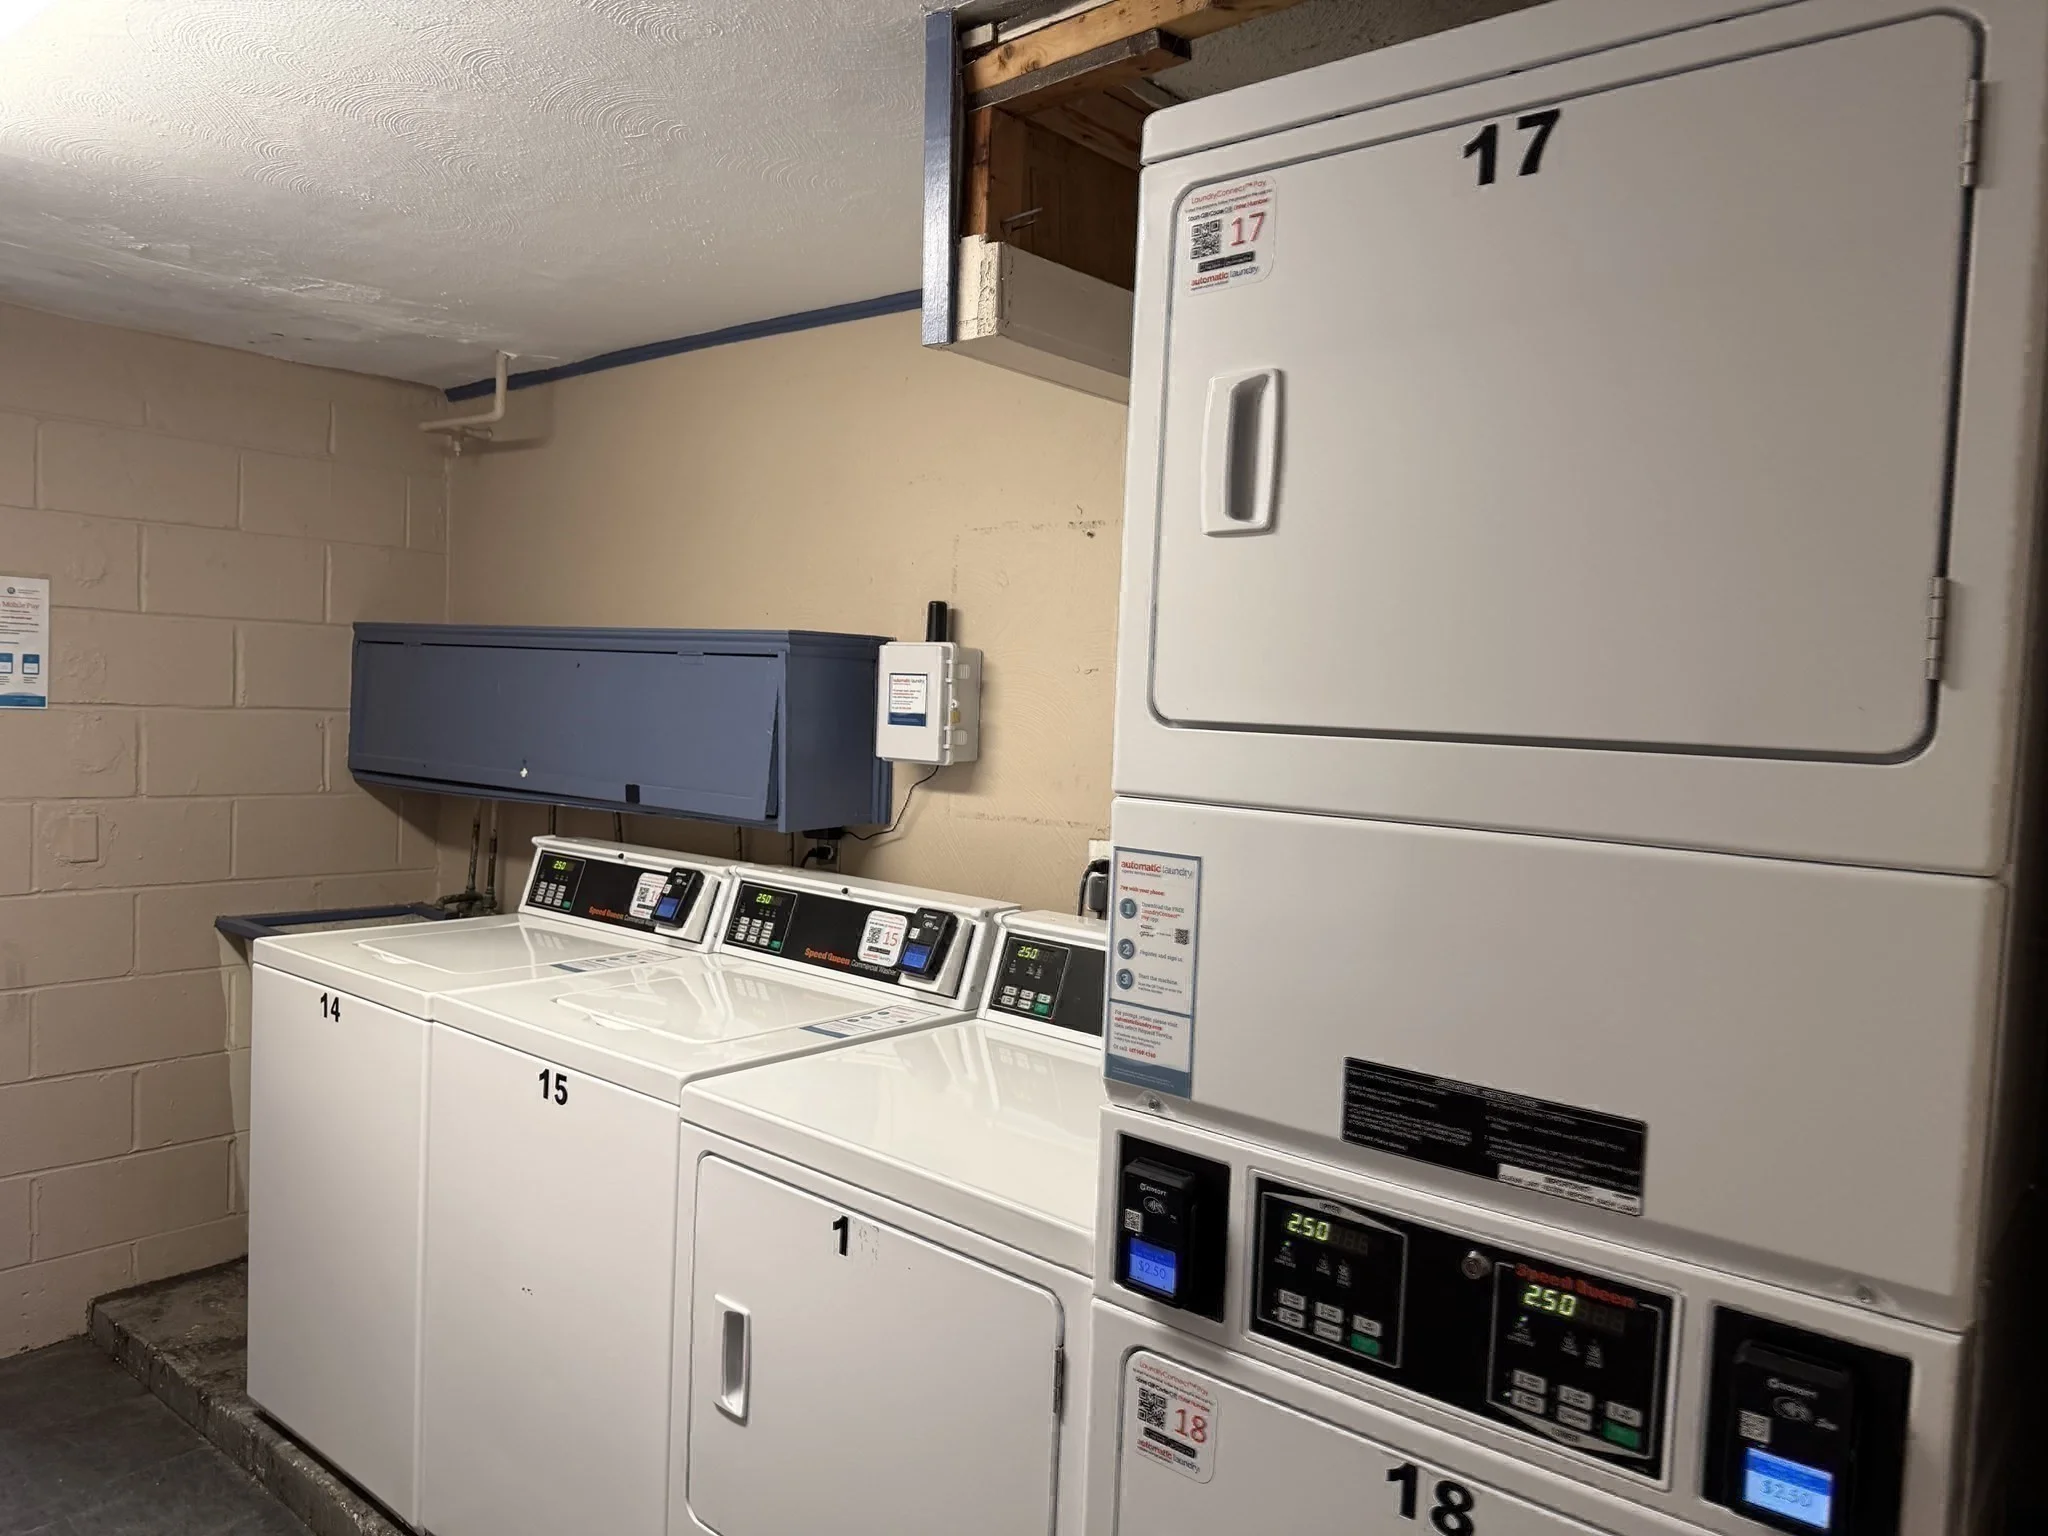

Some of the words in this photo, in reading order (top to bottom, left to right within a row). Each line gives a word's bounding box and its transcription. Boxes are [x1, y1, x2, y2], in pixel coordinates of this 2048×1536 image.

[1462, 108, 1560, 185] 17
[1231, 212, 1264, 246] 17
[1191, 272, 1229, 286] automatic
[1230, 266, 1258, 278] laundry
[1121, 860, 1161, 872] automatic
[1162, 865, 1192, 878] laundry
[882, 931, 898, 947] 15
[1122, 944, 1131, 955] 2
[804, 947, 826, 961] Speed
[828, 951, 850, 966] Queen
[1121, 973, 1129, 984] 3
[320, 992, 341, 1023] 14
[538, 1068, 568, 1106] 15
[833, 1216, 848, 1256] 1
[1138, 1260, 1166, 1280] $2.50
[1515, 1263, 1574, 1289] Speed
[1576, 1280, 1637, 1309] Queen
[1175, 1409, 1207, 1443] 18
[1386, 1462, 1474, 1536] 18
